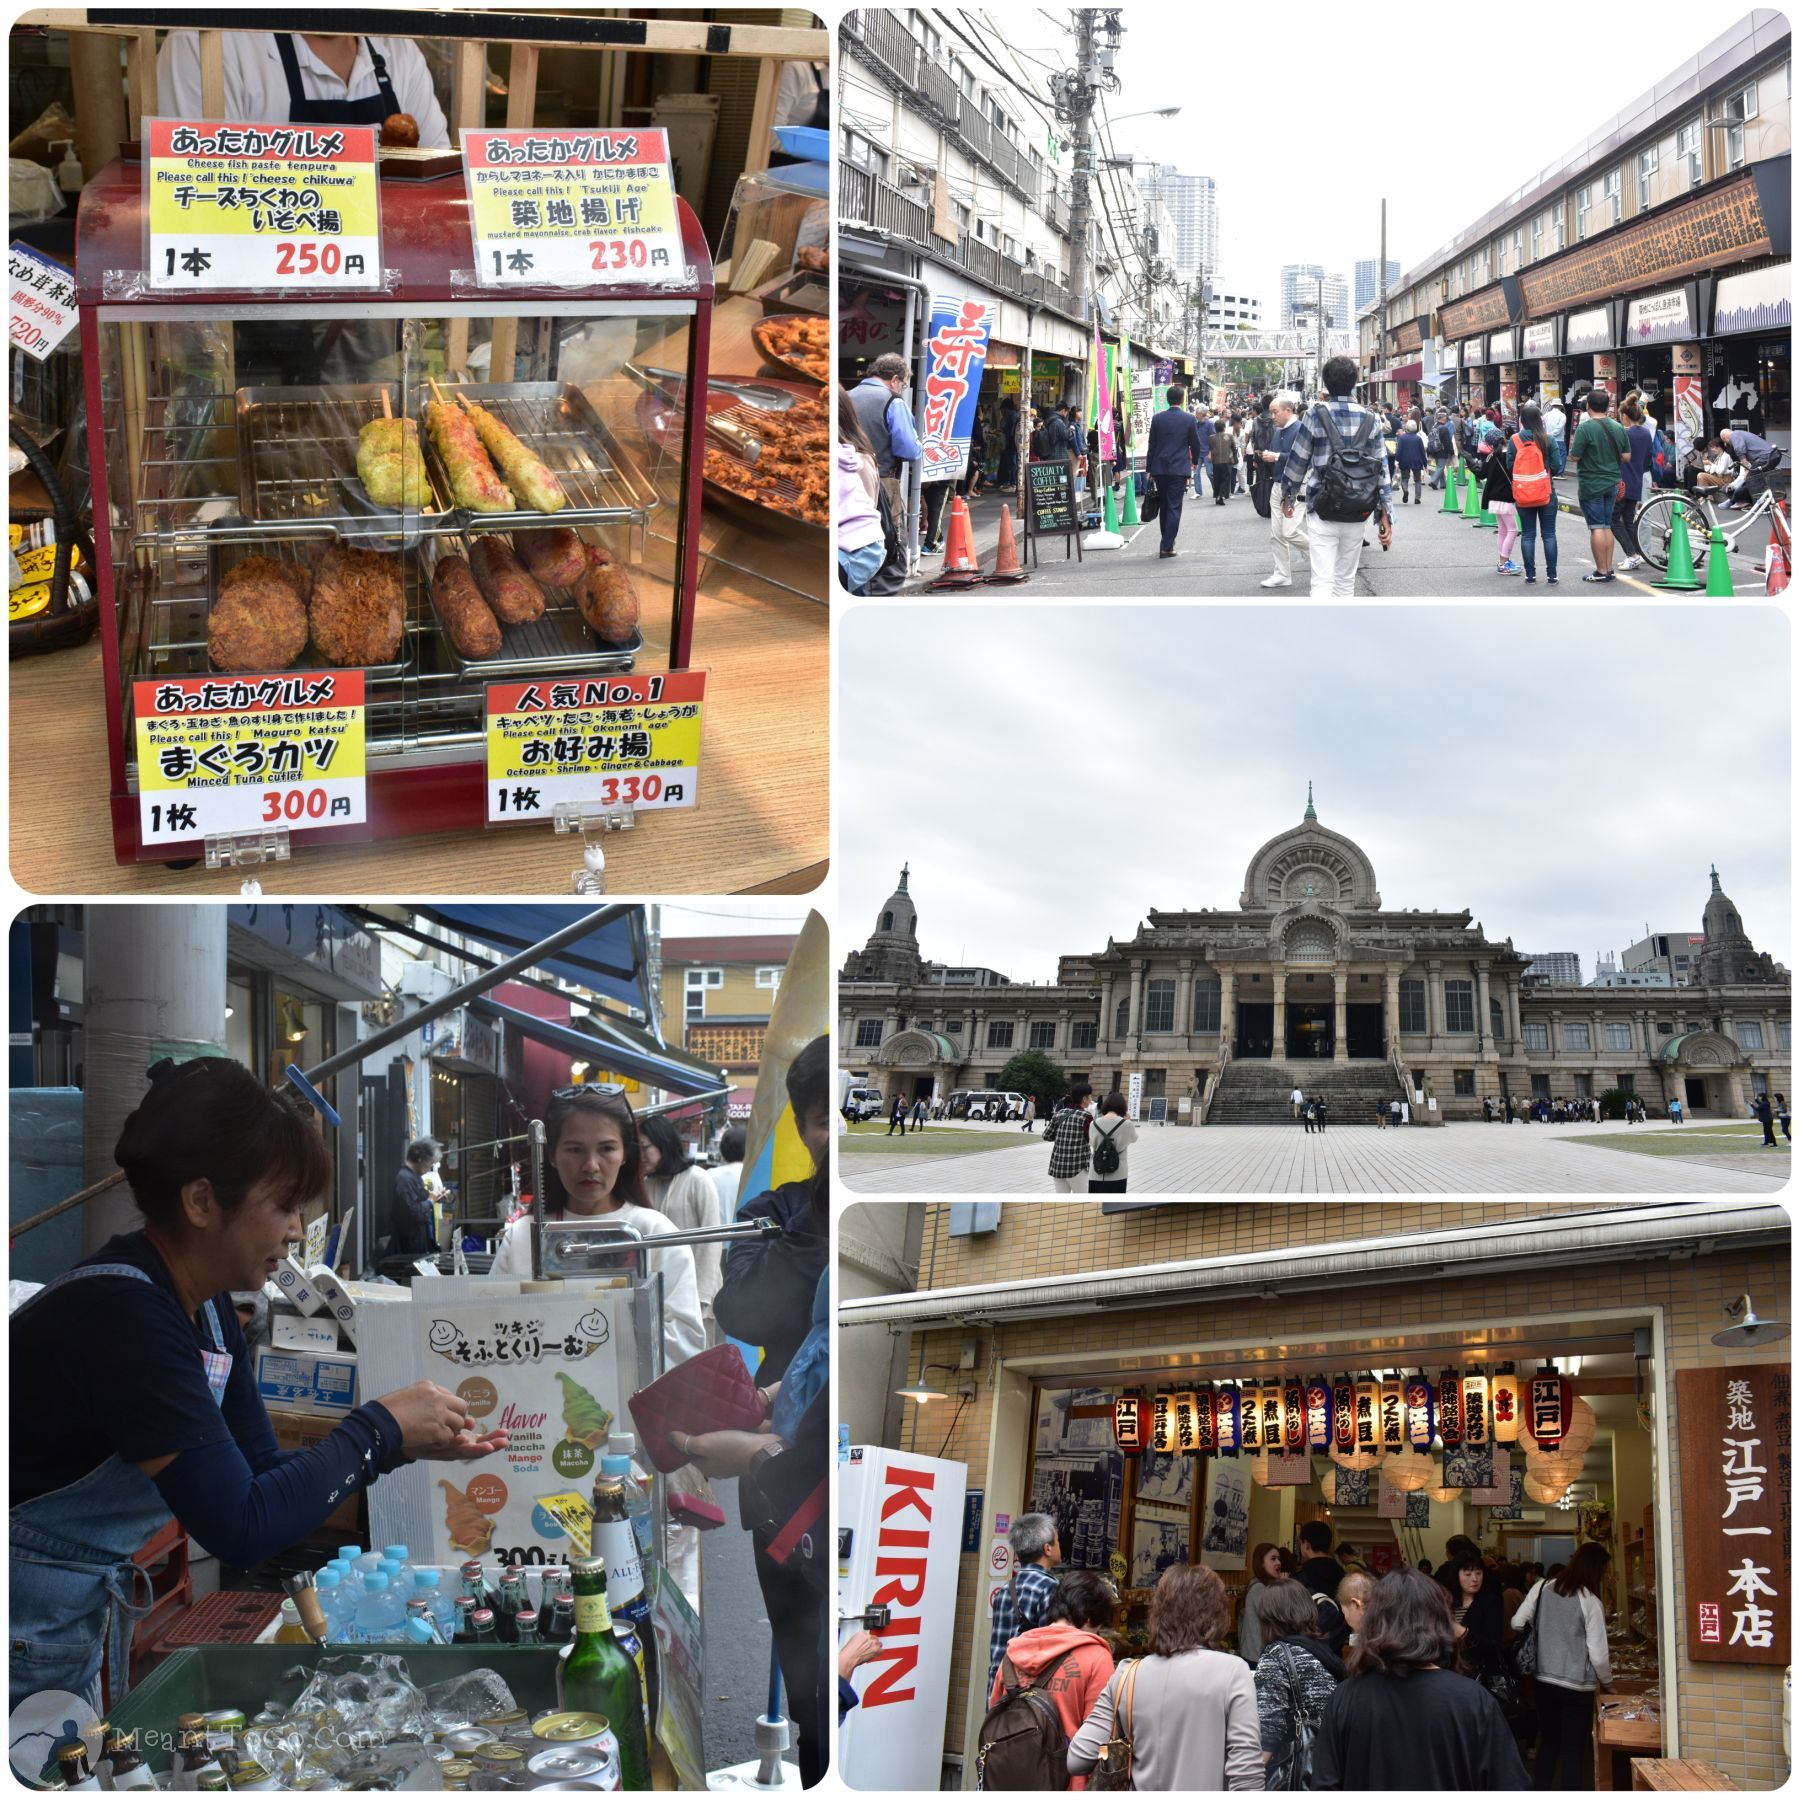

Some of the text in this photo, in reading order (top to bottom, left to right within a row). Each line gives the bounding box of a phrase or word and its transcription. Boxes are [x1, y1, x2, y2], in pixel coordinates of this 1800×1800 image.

[172, 127, 343, 156] あったかグルメ
[487, 136, 638, 165] あったかグルメ
[187, 158, 336, 172] Cheese fish paste tenpura
[477, 167, 660, 182] からしマヨネーズ入り かにかまぼこ
[157, 172, 193, 183] Please
[196, 172, 214, 183] call
[174, 186, 320, 209] チーズちくわの
[493, 187, 524, 197] Please
[527, 187, 543, 196] call
[253, 210, 341, 232] いそべ揚
[511, 198, 640, 228] 築地揚げ
[488, 230, 521, 239] mustard
[573, 228, 591, 236] crab
[593, 227, 618, 236] flavor
[622, 225, 663, 235] fishcake
[165, 247, 212, 277] 1本
[492, 249, 534, 276] 1本
[924, 300, 986, 441] 寿司
[1031, 466, 1065, 478] SPECIALTY
[1033, 476, 1058, 487] COFFEE
[156, 677, 334, 711] あったかグルメ
[150, 734, 184, 744] Please
[188, 732, 207, 742] call
[503, 729, 533, 739] Please
[537, 727, 556, 736] call
[159, 738, 337, 779] まぐろカツ
[522, 731, 650, 765] お好み揚
[187, 770, 304, 788] Minced Tuna cutlet
[506, 767, 546, 777] Octopus
[557, 764, 590, 775] Shrimp
[498, 786, 541, 812] 1枚
[151, 803, 197, 832] 1枚
[494, 1319, 540, 1335] ツキジ
[455, 1335, 584, 1362] そふとくりーむ
[463, 1390, 491, 1398] バニラ
[1357, 1396, 1373, 1442] 煮豆
[1534, 1380, 1561, 1437] 江戸一
[1117, 1399, 1138, 1447] 江戸一
[1264, 1400, 1281, 1444] 煮豆
[506, 1432, 543, 1441] Vanilla
[508, 1454, 543, 1463] Mango
[560, 1459, 589, 1467] Maccha
[562, 1449, 583, 1460] 抹茶
[513, 1464, 539, 1473] Soda
[470, 1487, 504, 1495] マンゴー
[1722, 1379, 1778, 1649] 築地 江戸一 本店
[862, 1465, 935, 1710] KIRIN
[1700, 1604, 1720, 1642] 江戸一
